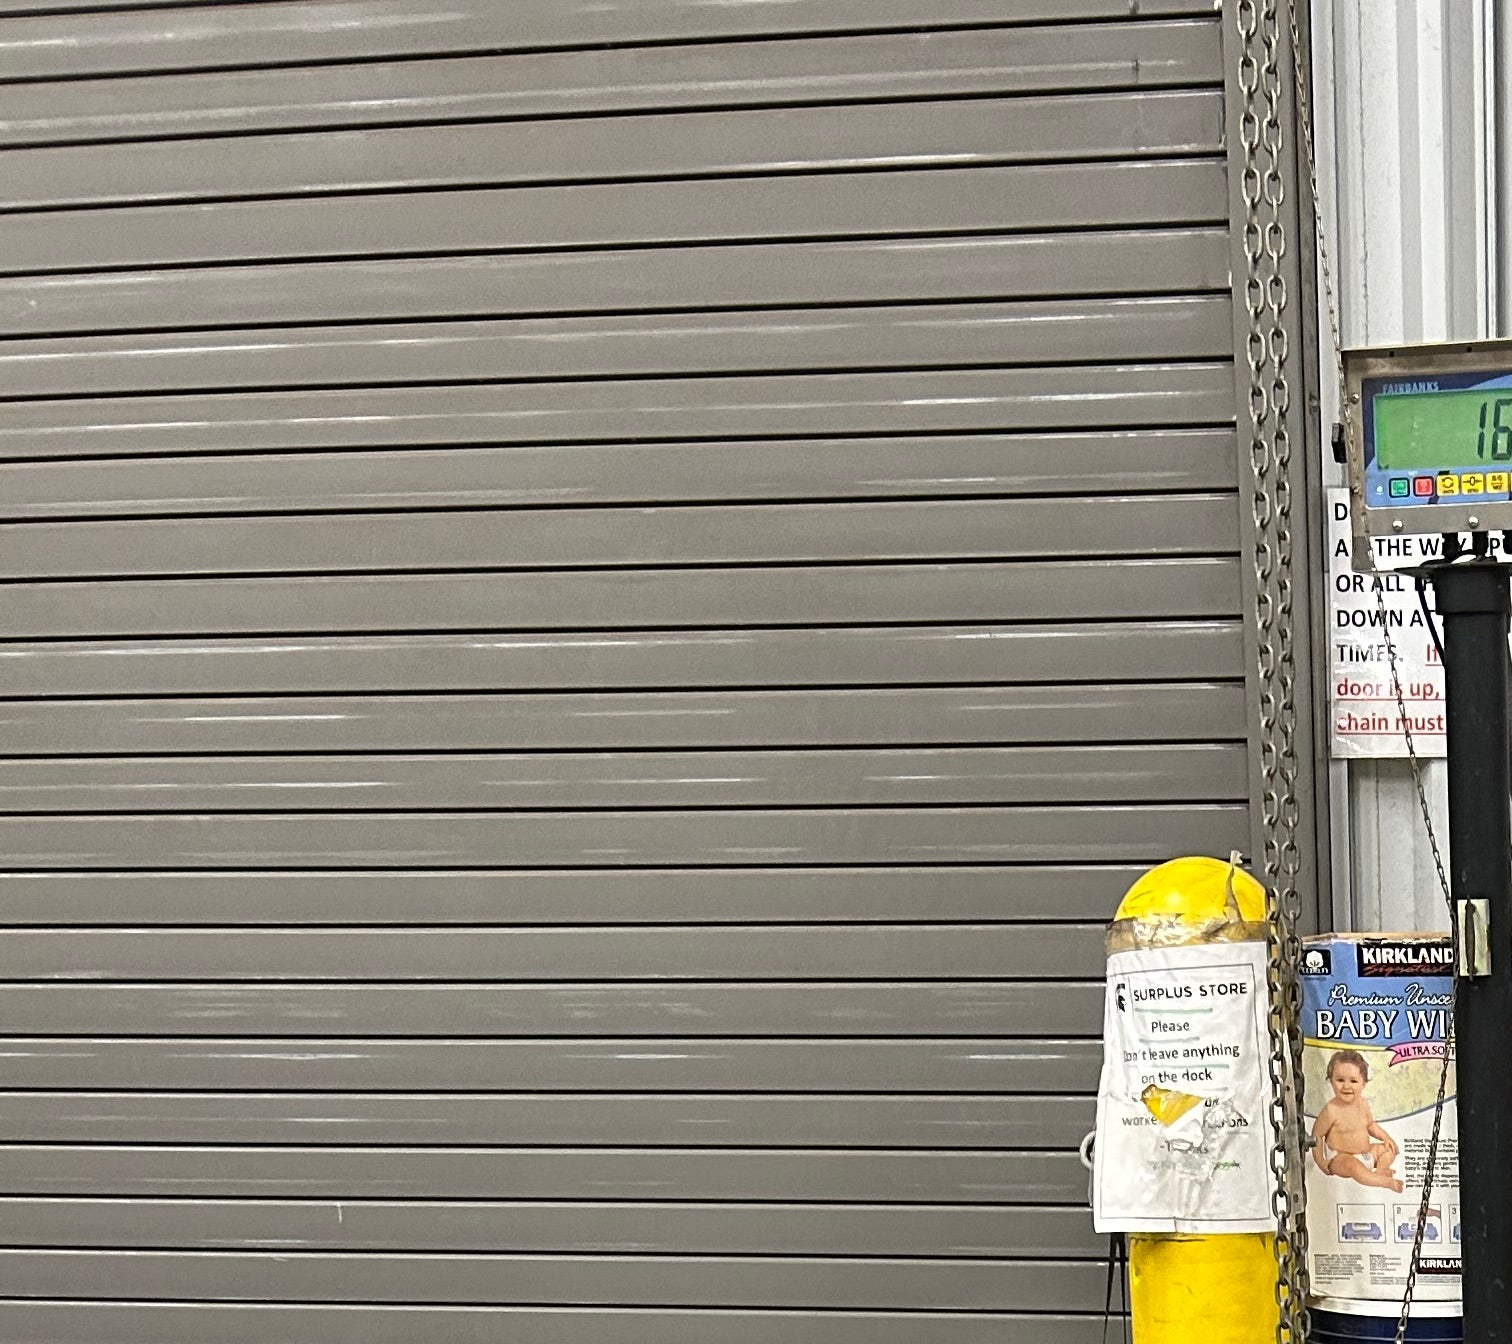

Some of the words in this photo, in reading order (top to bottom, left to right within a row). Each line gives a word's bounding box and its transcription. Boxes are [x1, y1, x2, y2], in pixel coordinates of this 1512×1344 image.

[1382, 382, 1439, 395] FAIRBANKS
[1375, 538, 1412, 556] THE
[1418, 538, 1467, 556] WY
[1336, 574, 1364, 592] OR
[1371, 575, 1405, 592] ALL
[1336, 609, 1403, 627] DOWN
[1336, 644, 1404, 662] TIMES.
[1337, 677, 1383, 696] door
[1410, 683, 1440, 701] up,
[1337, 712, 1389, 731] chain
[1395, 714, 1444, 731] must
[1362, 947, 1454, 964] KIRKLAND
[1133, 985, 1193, 1002] SURPLUS
[1199, 982, 1248, 997] STORE
[1328, 983, 1403, 1007] Premium
[1405, 983, 1453, 1007] Unsce
[1151, 1020, 1191, 1033] Please
[1316, 1009, 1399, 1039] BABY
[1406, 1009, 1455, 1039] WI
[1148, 1047, 1179, 1061] leave
[1182, 1043, 1241, 1061] anything
[1400, 1046, 1432, 1058] ULTRA
[1141, 1074, 1156, 1084] on
[1158, 1070, 1178, 1084] the
[1182, 1067, 1213, 1082] dock
[1419, 1259, 1462, 1269] KIRKLAN
